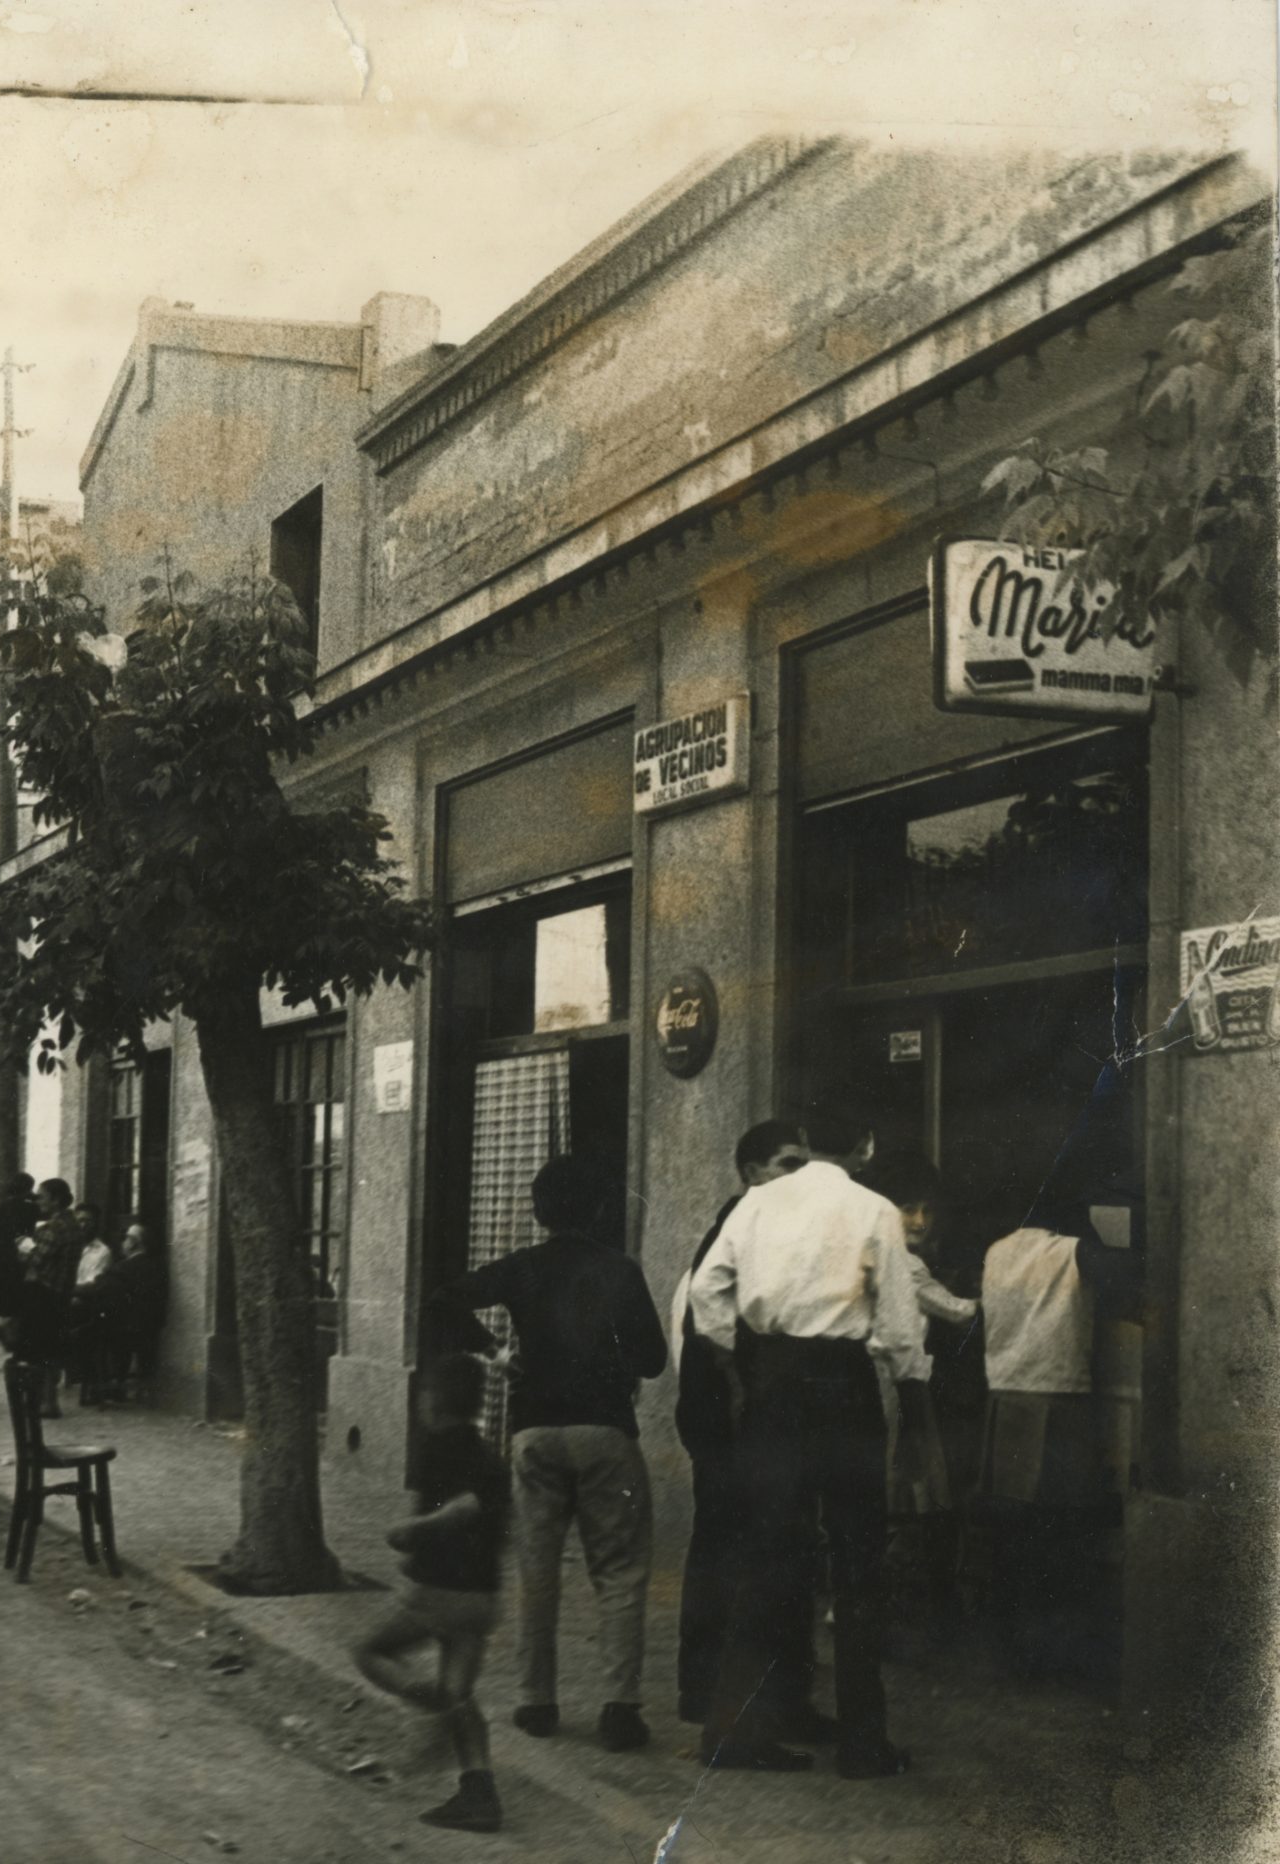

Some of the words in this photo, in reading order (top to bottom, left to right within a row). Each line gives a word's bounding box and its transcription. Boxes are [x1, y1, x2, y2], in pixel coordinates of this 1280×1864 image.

[970, 556, 1155, 657] Maria
[1041, 668, 1111, 692] mamma
[635, 702, 727, 763] AGRUPACION
[635, 768, 651, 794] DE
[658, 736, 727, 786] VECINOS
[1220, 1034, 1268, 1048] GUSTO
